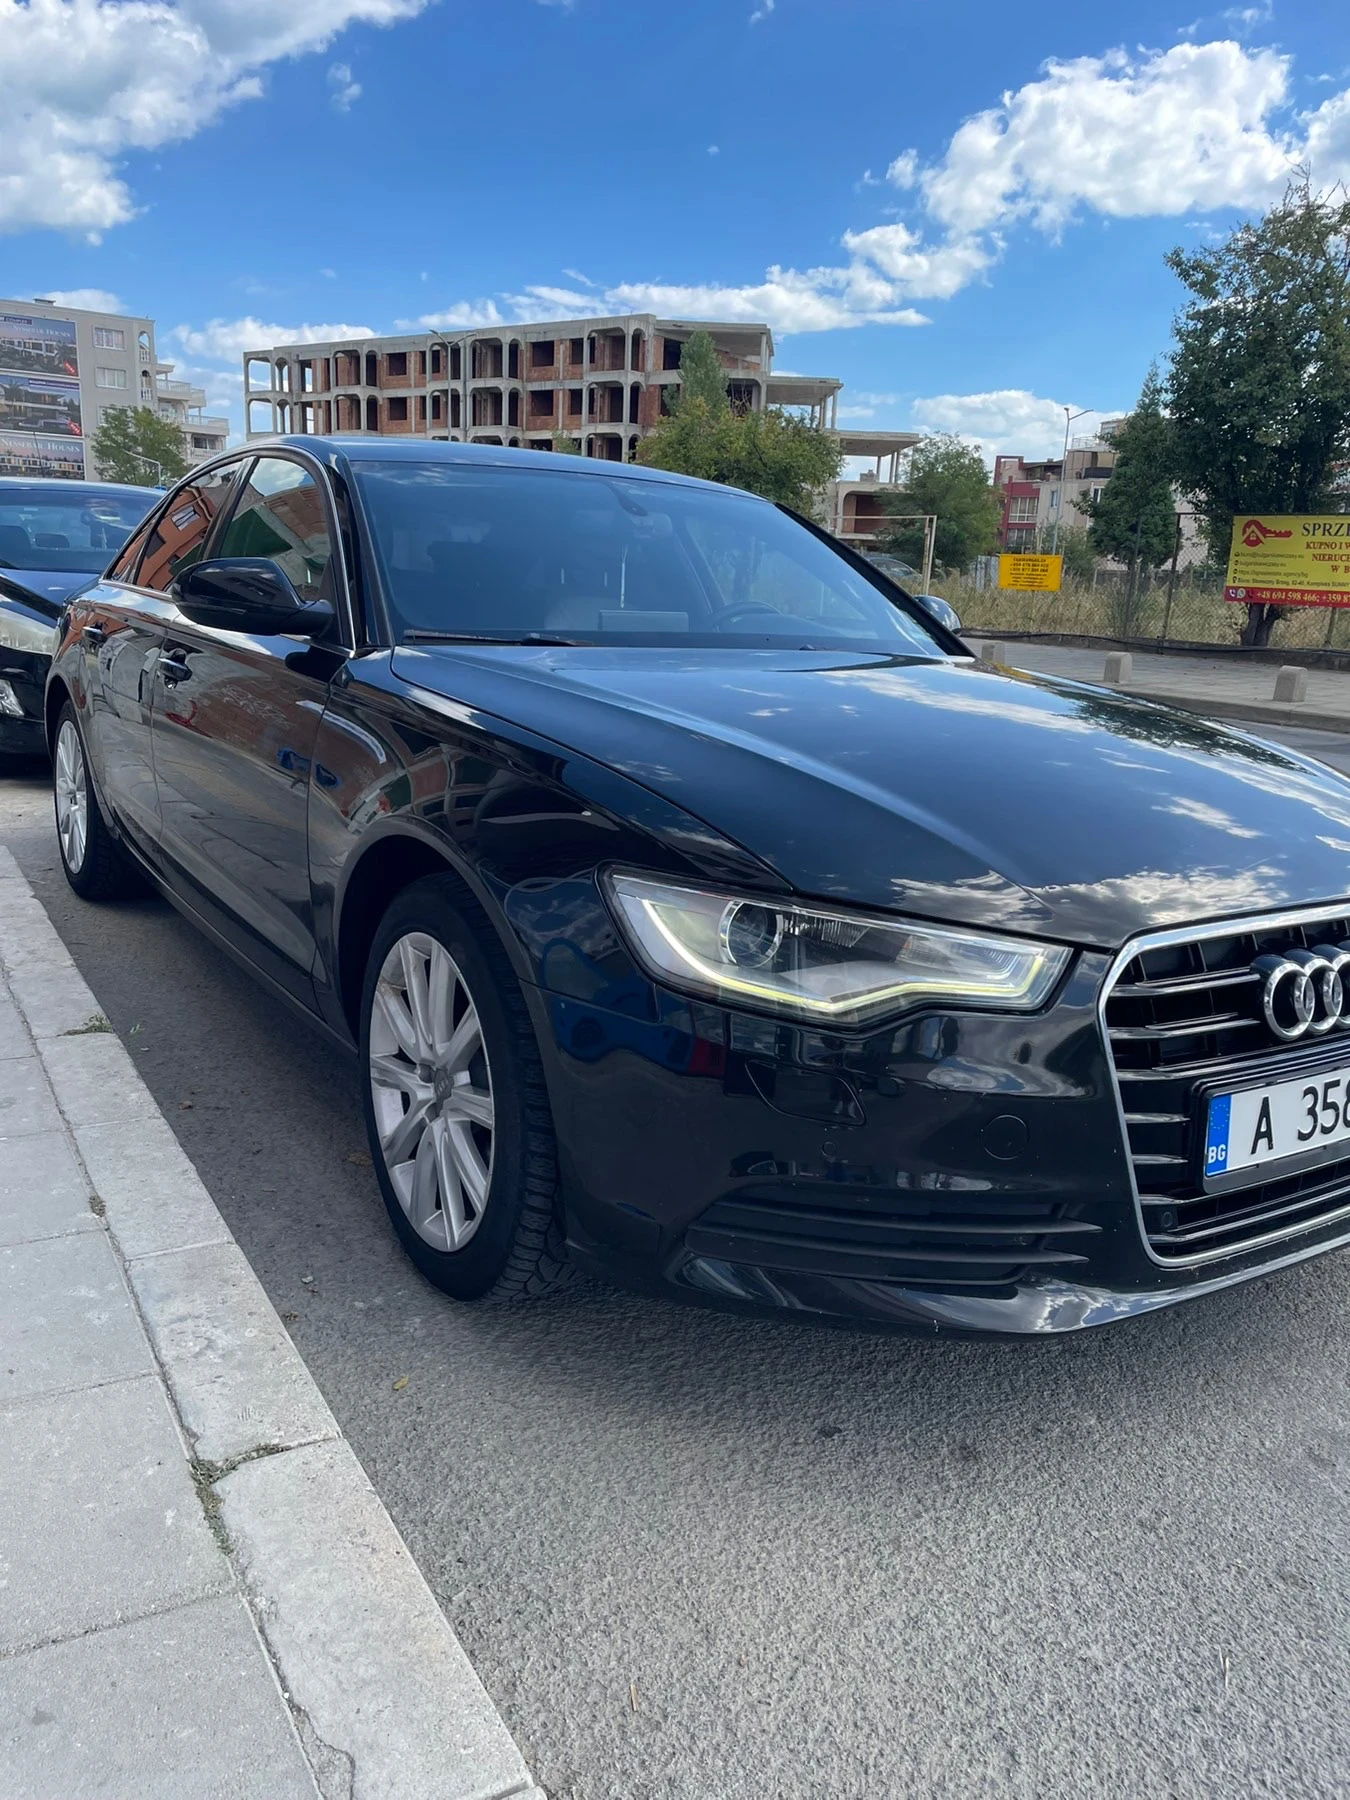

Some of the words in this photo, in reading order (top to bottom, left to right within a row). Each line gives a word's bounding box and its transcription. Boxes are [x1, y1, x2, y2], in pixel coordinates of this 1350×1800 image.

[1305, 541, 1337, 550] KUPNO
[1331, 565, 1340, 573] W
[1272, 591, 1285, 600] 694
[1287, 592, 1301, 600] 598
[1322, 594, 1342, 602] +359
[1251, 1096, 1274, 1155] A
[1208, 1144, 1226, 1163] BG
